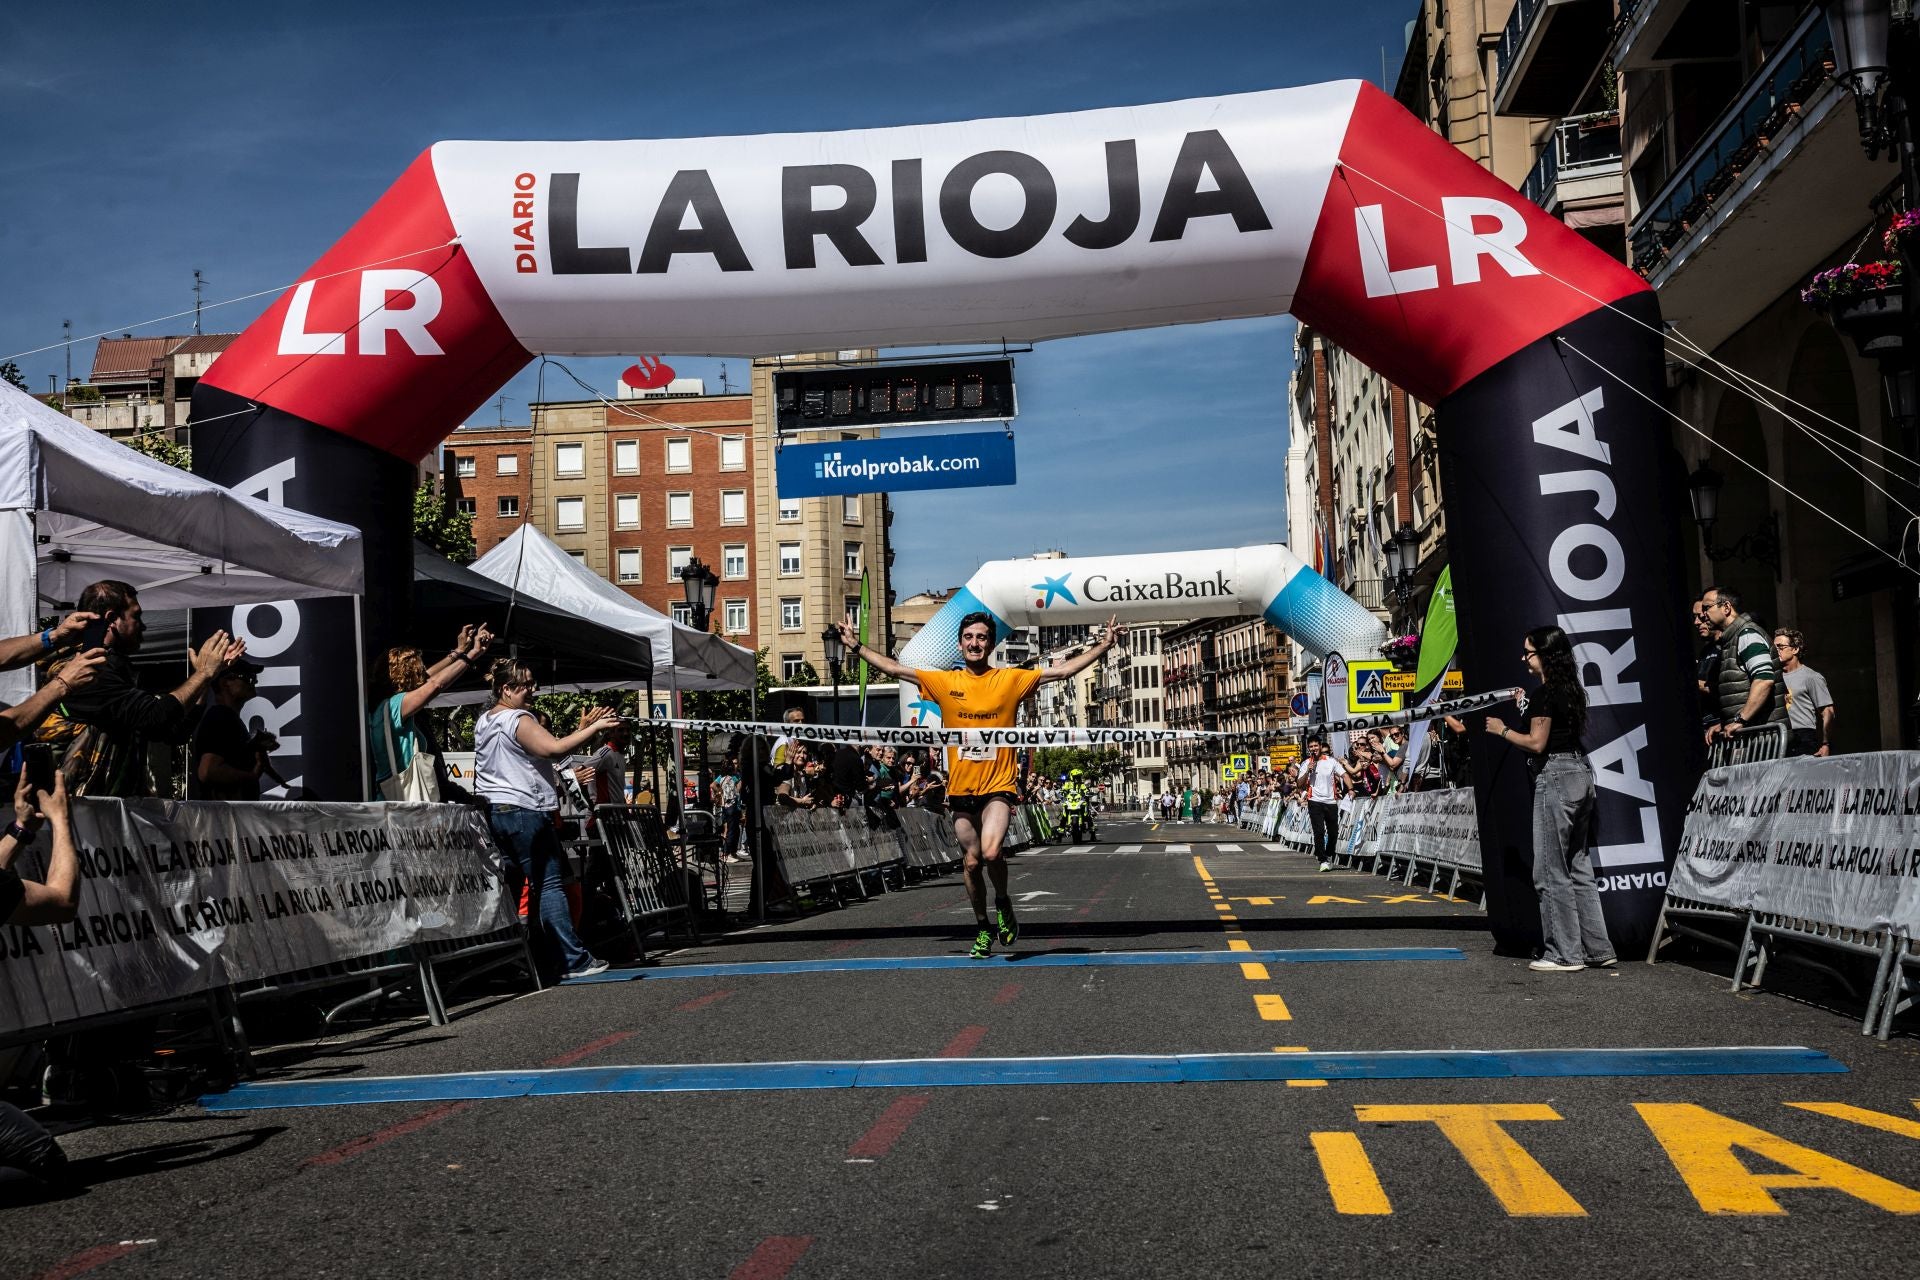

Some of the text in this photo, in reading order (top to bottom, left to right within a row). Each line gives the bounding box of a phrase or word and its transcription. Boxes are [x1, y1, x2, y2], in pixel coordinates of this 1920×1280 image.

[548, 128, 1274, 275] LA RIOJA
[515, 172, 537, 274] DIARIO
[1354, 196, 1542, 299] LR
[277, 268, 447, 356] LR
[823, 455, 981, 481] Kirolprobak.com
[1083, 569, 1235, 603] CaixaBank
[1532, 386, 1666, 868] LA RIOJA
[1384, 674, 1404, 682] hotel
[1384, 679, 1464, 689] Marqué allej
[1333, 714, 1393, 732] RIOJA
[1411, 707, 1436, 723] LA
[780, 725, 863, 742] LA RIOJA
[876, 729, 963, 745] LA RIOJA
[979, 730, 1040, 745] RIOJA
[1044, 730, 1070, 745] LA
[1085, 729, 1147, 744] RIOJA
[1787, 788, 1804, 814] LA
[1803, 788, 1835, 815] RIOJA
[1844, 788, 1859, 815] LA
[1860, 788, 1898, 816] RIOJA
[151, 837, 237, 873] LA RIOJA
[245, 832, 318, 863] LA RIOJA
[325, 827, 392, 857] LA RIOJA
[1777, 840, 1793, 866] LA
[1791, 841, 1823, 869] RIOJA
[1829, 844, 1846, 871] LA
[1845, 844, 1884, 876] RIOJA
[1890, 847, 1909, 876] LA
[340, 876, 408, 908] LA RIOJA
[1597, 870, 1667, 892] DIARIO
[168, 896, 254, 936] LA RIOJA
[261, 885, 335, 920] LA RIOJA
[57, 909, 157, 951] LA RIOJA
